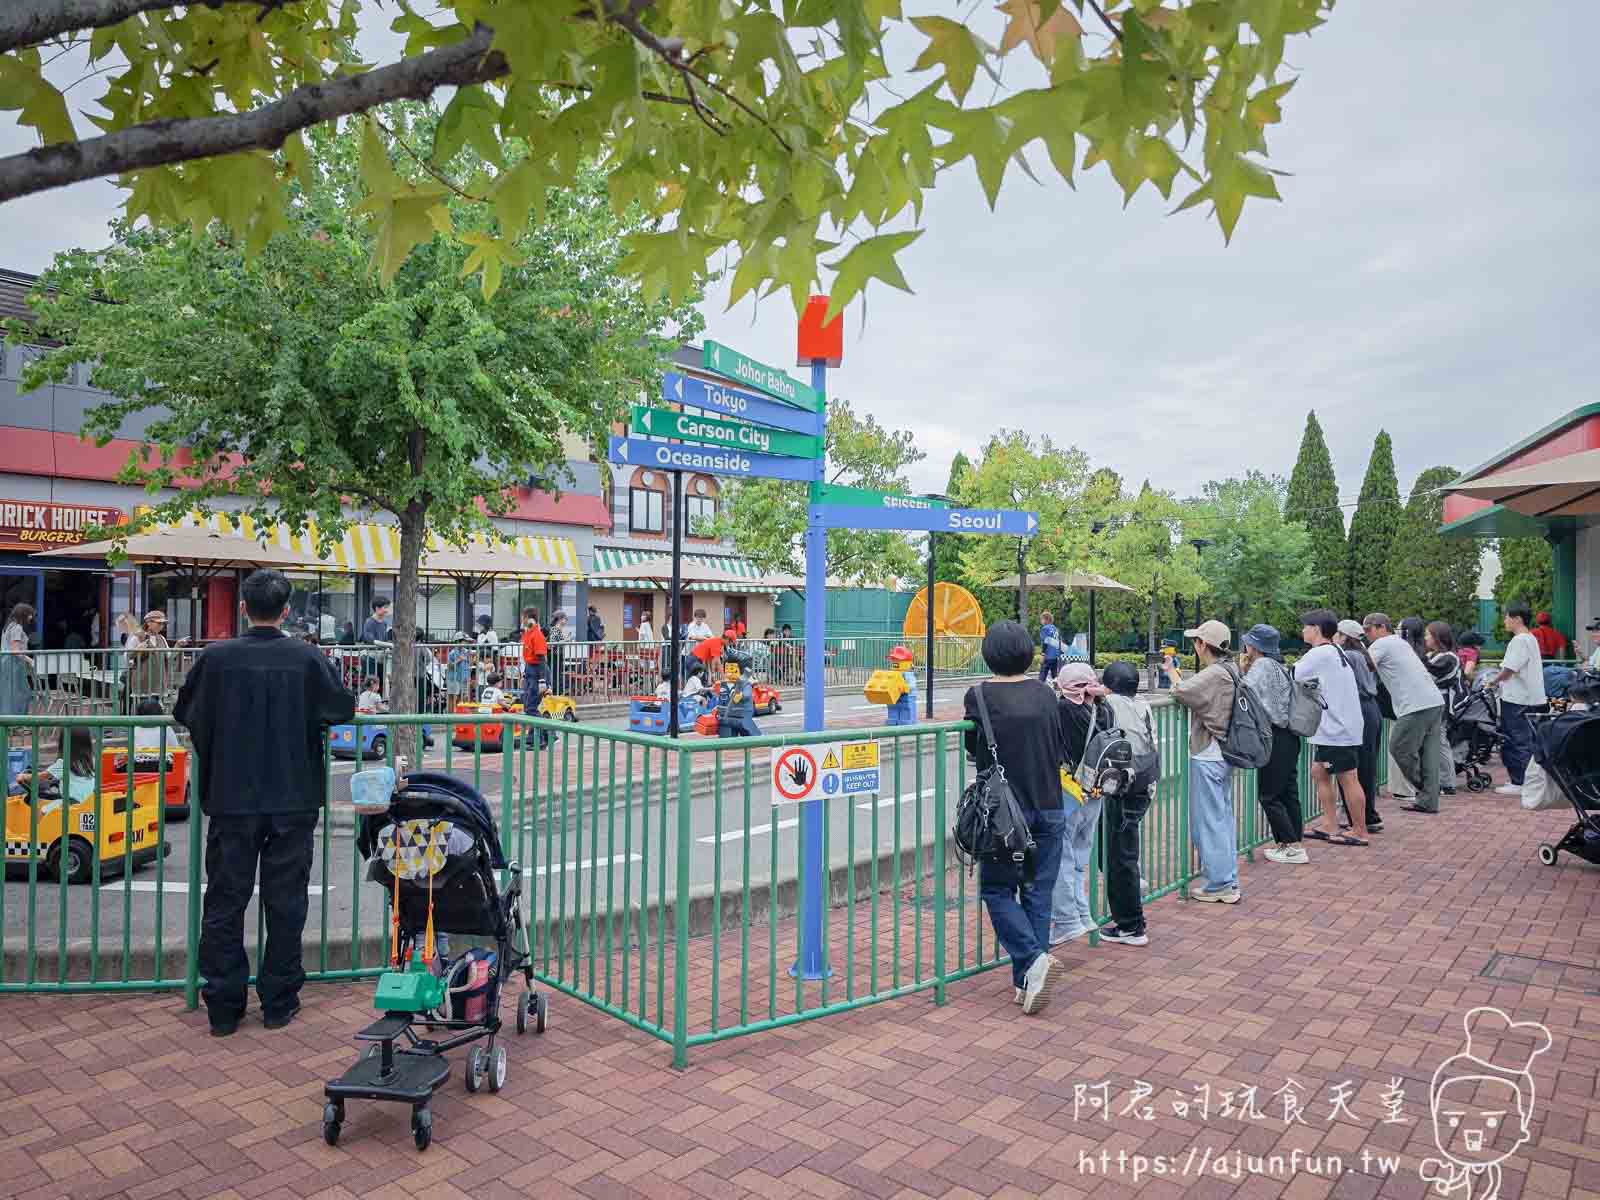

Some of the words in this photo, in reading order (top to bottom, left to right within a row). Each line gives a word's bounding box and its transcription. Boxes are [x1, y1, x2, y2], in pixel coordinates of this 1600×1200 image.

[735, 358, 767, 384] Johor
[704, 384, 747, 413] Tokyo
[676, 416, 736, 441] Carson
[738, 424, 770, 451] City
[655, 446, 751, 472] Oceanside
[51, 507, 108, 531] HOUSE
[949, 512, 1001, 529] Seoul
[20, 530, 83, 543] BURGERS
[83, 814, 94, 824] 02
